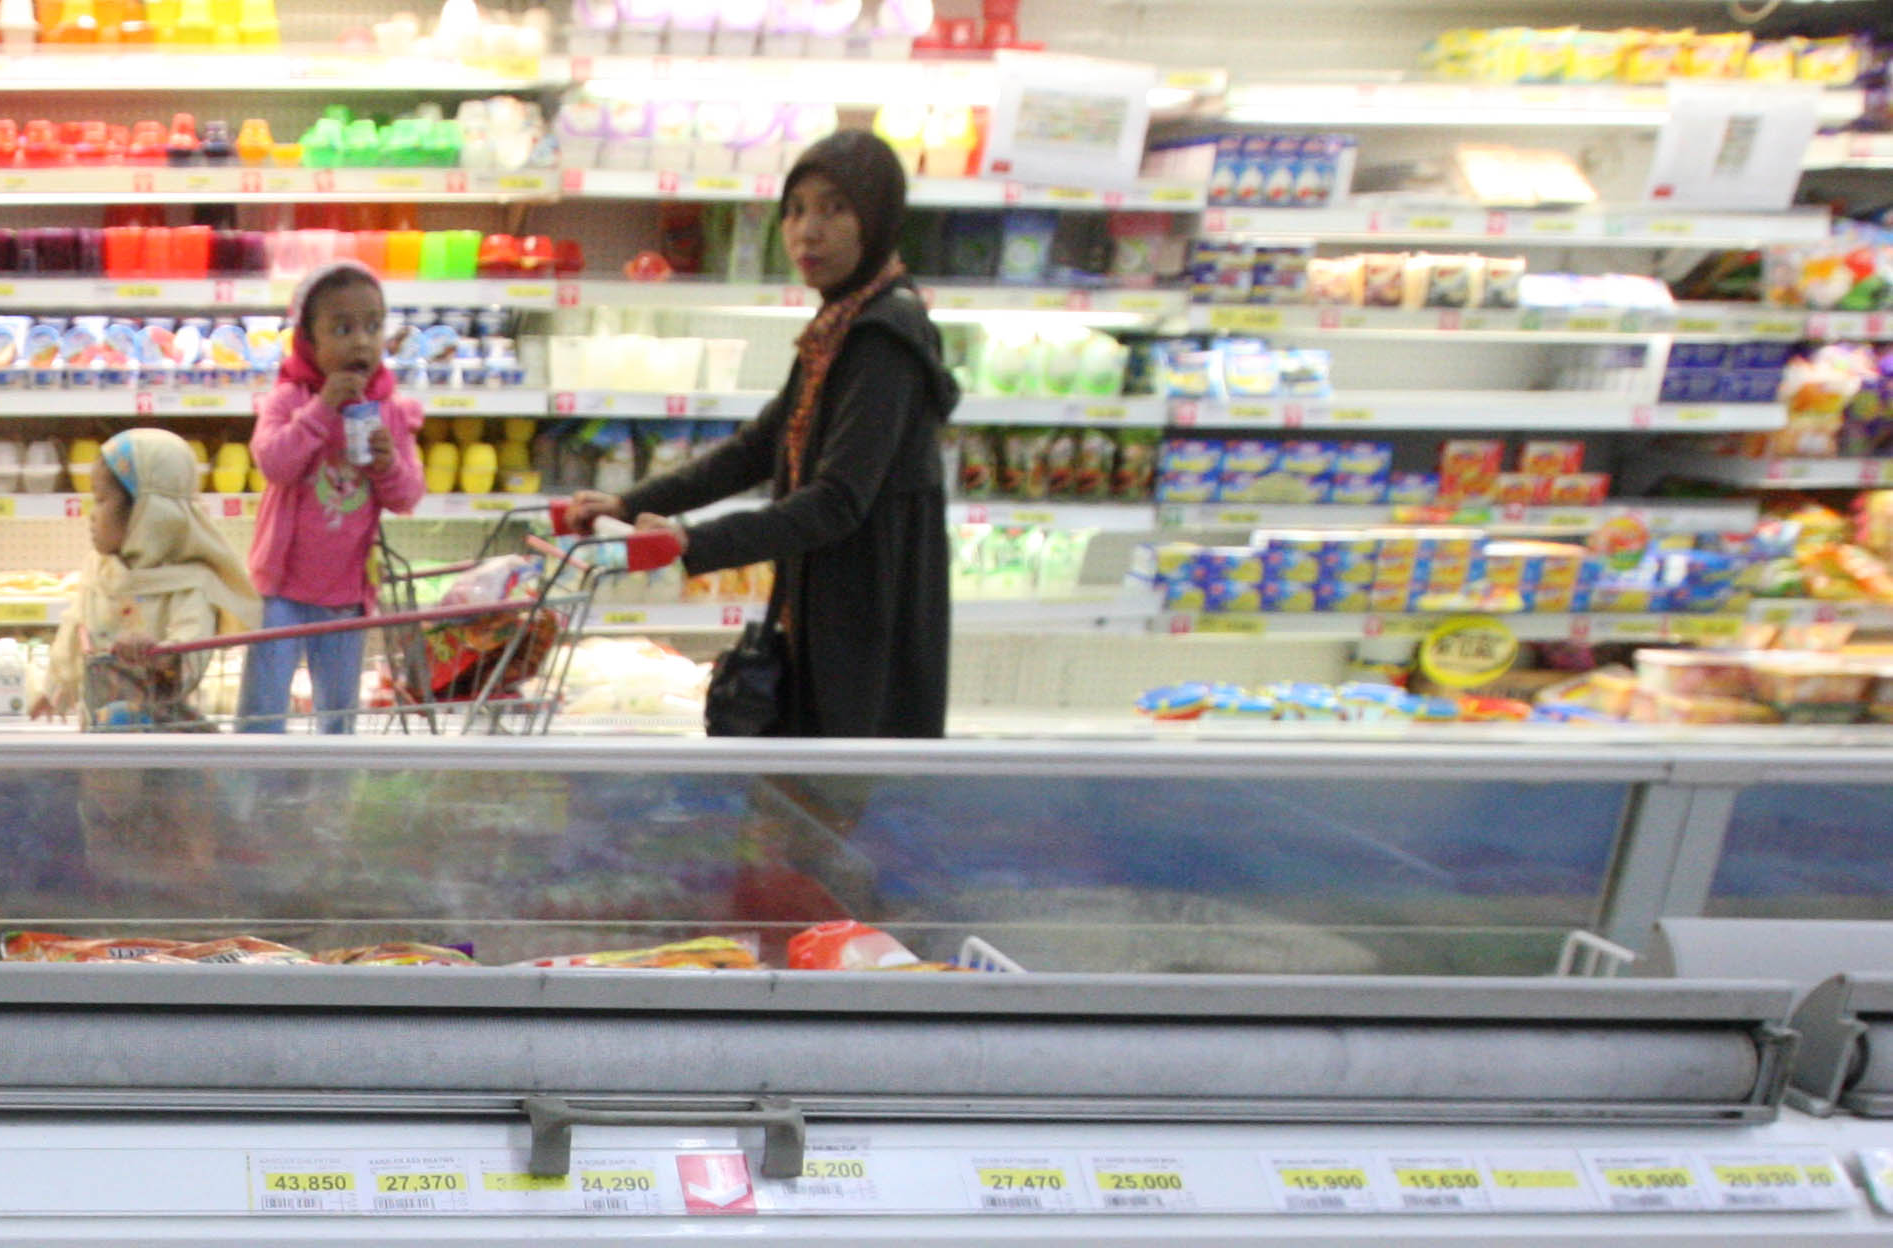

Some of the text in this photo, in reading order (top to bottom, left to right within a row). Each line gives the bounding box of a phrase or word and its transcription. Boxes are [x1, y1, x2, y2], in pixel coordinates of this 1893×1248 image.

[802, 1162, 864, 1179] 5,200
[274, 1175, 347, 1192] 43,850
[385, 1175, 457, 1192] 27,370
[581, 1175, 650, 1193] 24,290
[991, 1175, 1061, 1191] 27,470
[1113, 1174, 1182, 1191] 25,000
